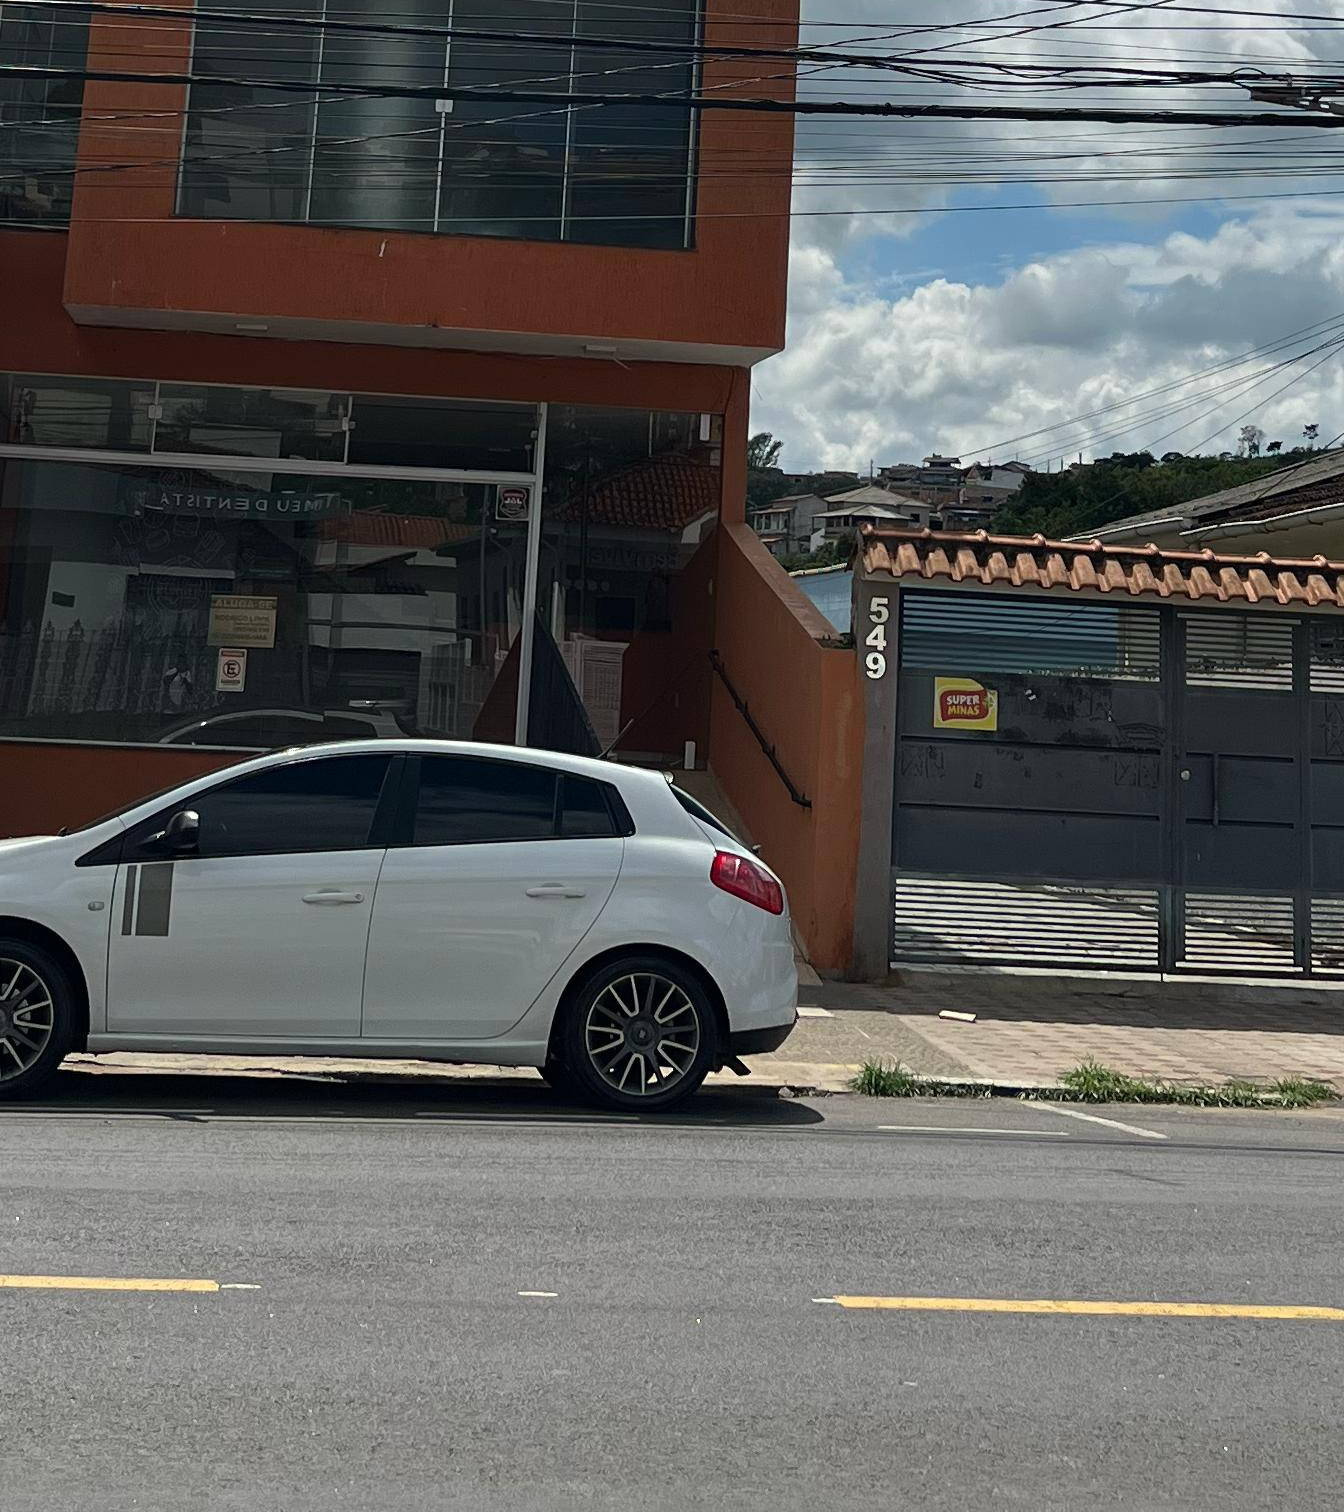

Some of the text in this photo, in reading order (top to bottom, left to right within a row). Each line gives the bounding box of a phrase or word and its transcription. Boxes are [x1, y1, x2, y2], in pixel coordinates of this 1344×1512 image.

[865, 596, 890, 680] 549
[946, 694, 980, 705] SUPER
[947, 705, 980, 716] MINAS
